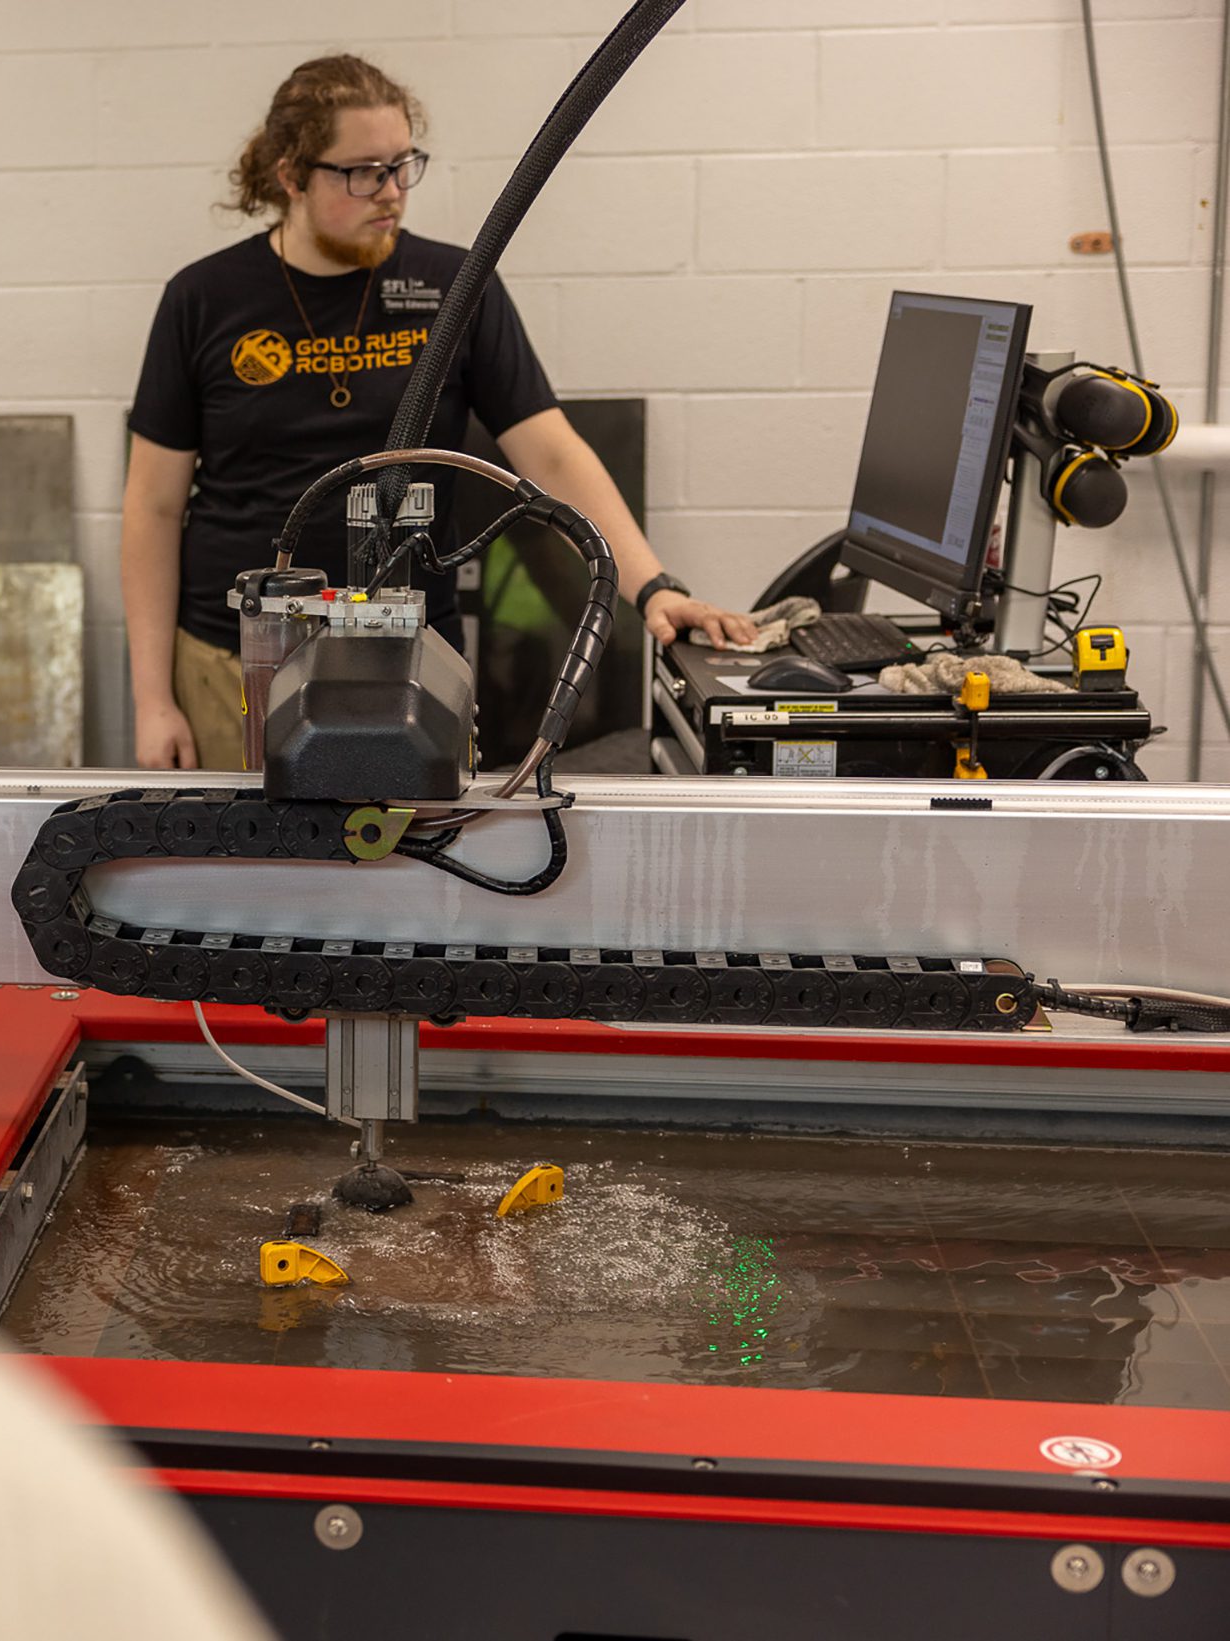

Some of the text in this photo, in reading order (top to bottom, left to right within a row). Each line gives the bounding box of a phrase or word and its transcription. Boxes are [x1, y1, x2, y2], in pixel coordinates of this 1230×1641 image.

[295, 327, 428, 356] GOLD RUSH
[295, 348, 413, 374] ROBOTICS
